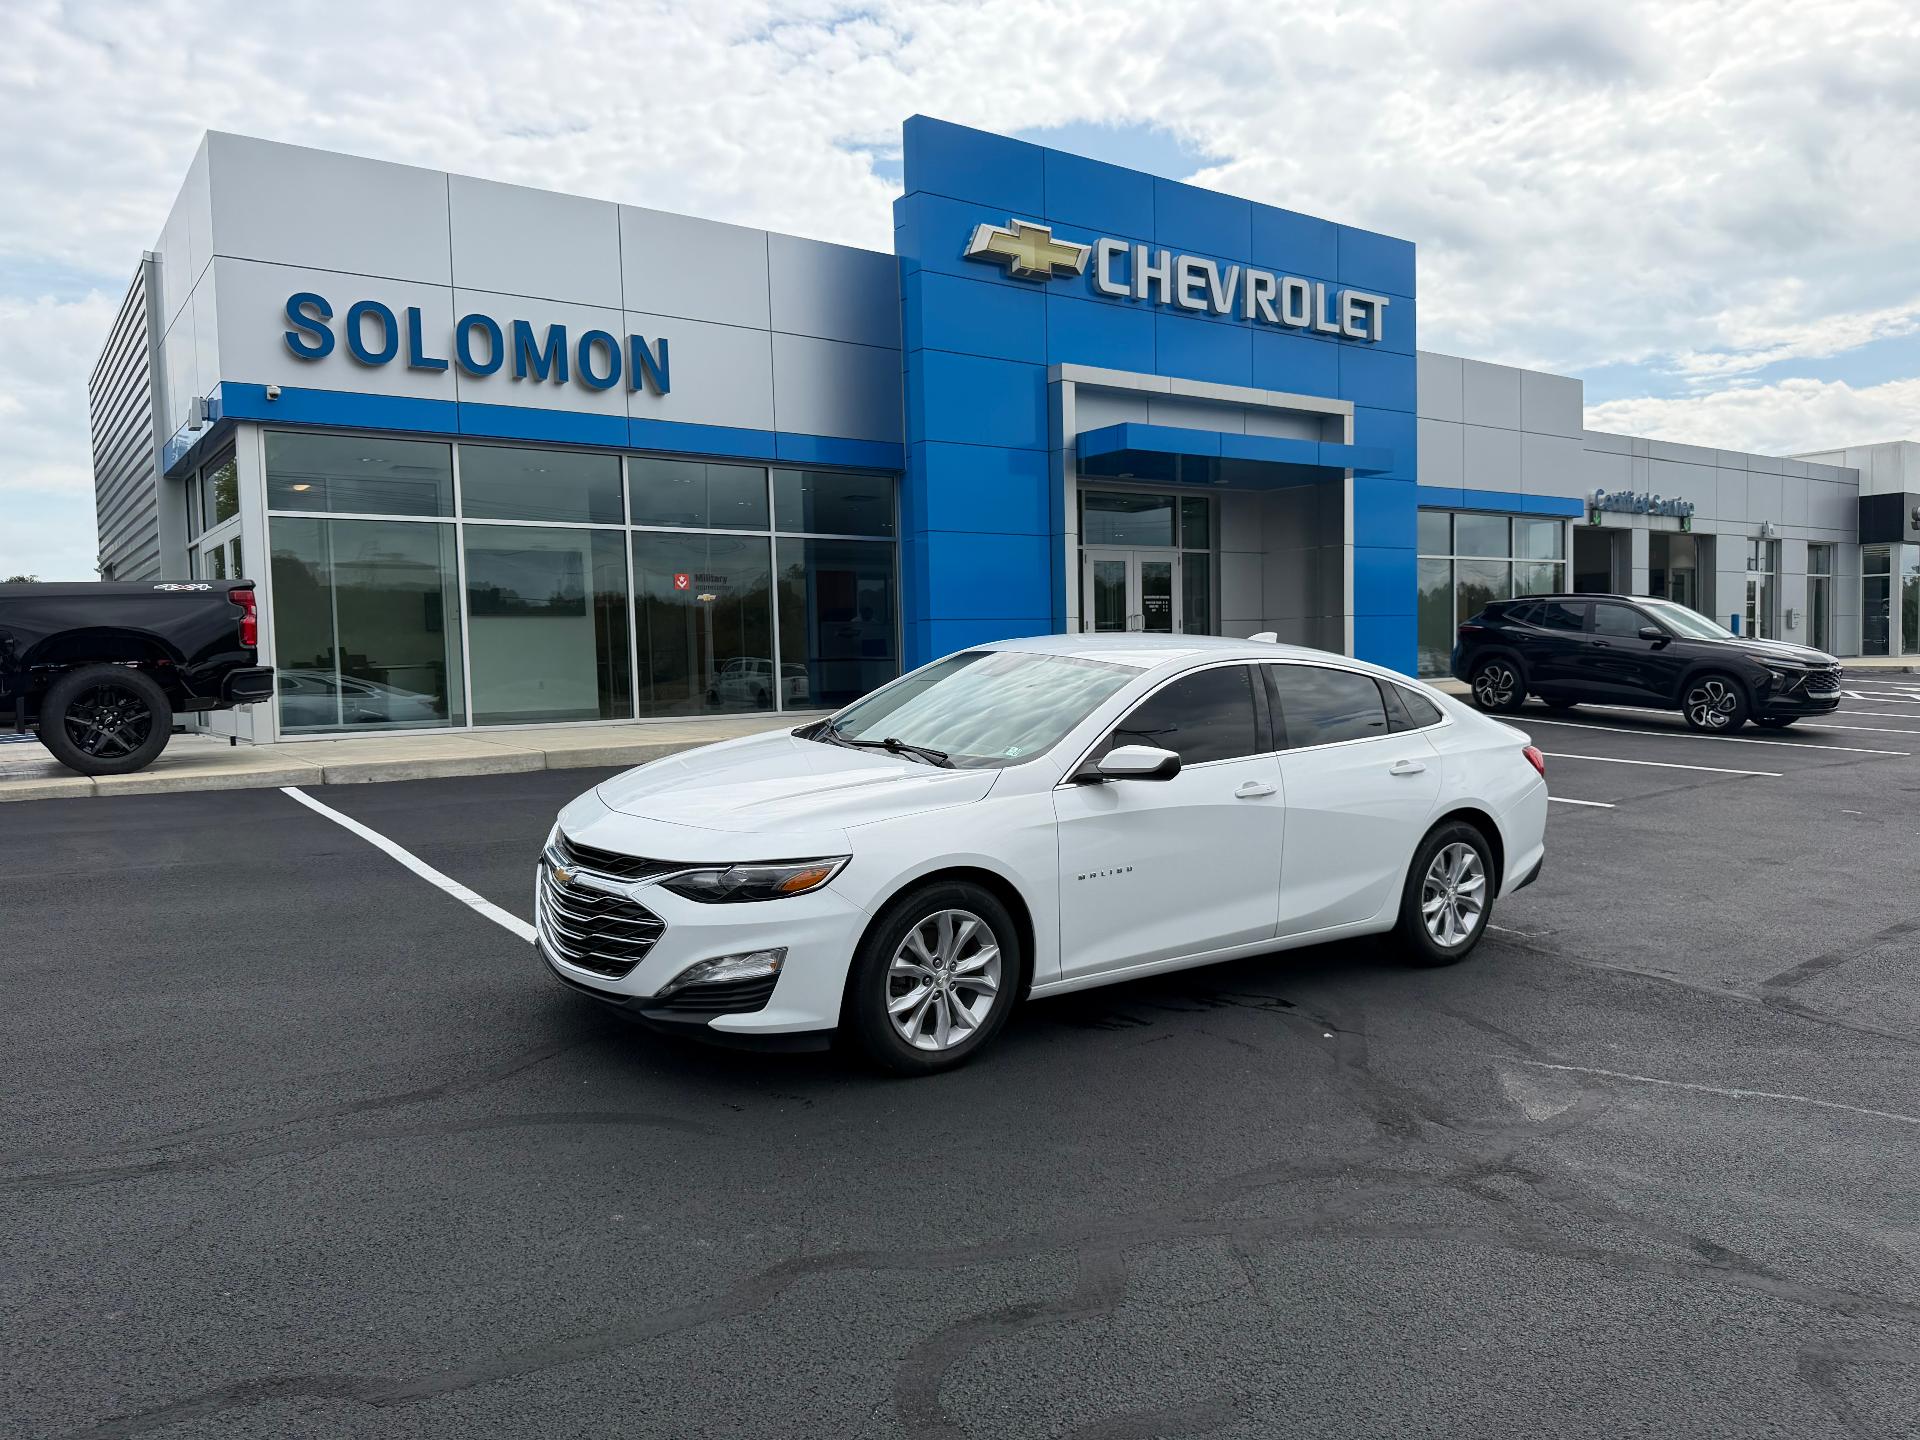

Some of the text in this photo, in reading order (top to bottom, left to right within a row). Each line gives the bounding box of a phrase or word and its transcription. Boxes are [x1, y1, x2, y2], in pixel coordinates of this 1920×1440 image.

[1093, 238, 1389, 342] CHEVROLET
[284, 292, 670, 394] SOLOMON
[1595, 489, 1695, 517] Certified Service
[695, 574, 727, 584] Military
[1078, 866, 1133, 879] MALIBU
